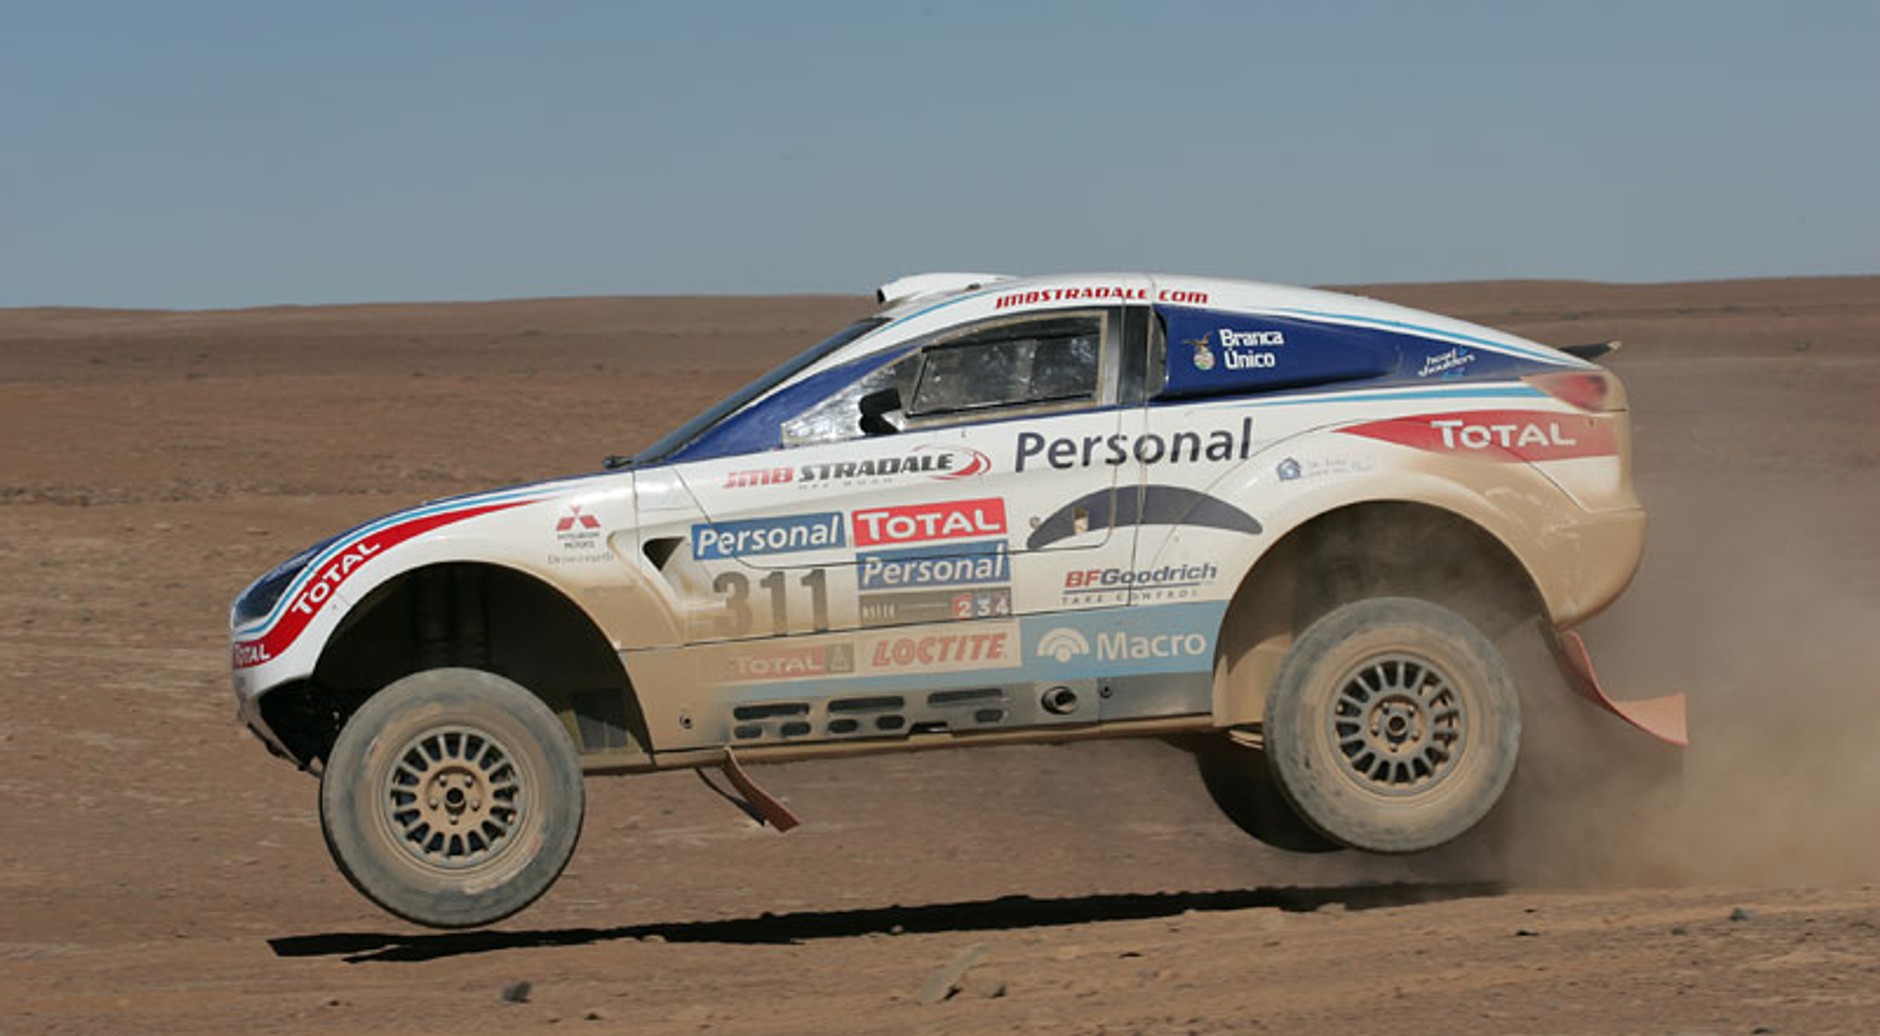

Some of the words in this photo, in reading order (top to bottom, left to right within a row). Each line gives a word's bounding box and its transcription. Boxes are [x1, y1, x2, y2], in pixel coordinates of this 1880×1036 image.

[1218, 328, 1285, 349] Branca
[1223, 347, 1277, 370] Único
[1015, 417, 1253, 473] Personal
[1431, 420, 1576, 448] TOTAL
[799, 453, 954, 482] STRADALE
[697, 516, 840, 555] Personal
[858, 508, 1000, 541] TOTAL
[291, 540, 380, 615] TOTAL
[861, 543, 1004, 585] Personal
[1065, 563, 1217, 588] BFGoodrich
[713, 569, 829, 635] 311
[872, 633, 1008, 666] LOCTITE
[1097, 630, 1207, 661] Macro
[735, 651, 824, 676] TOTAL
